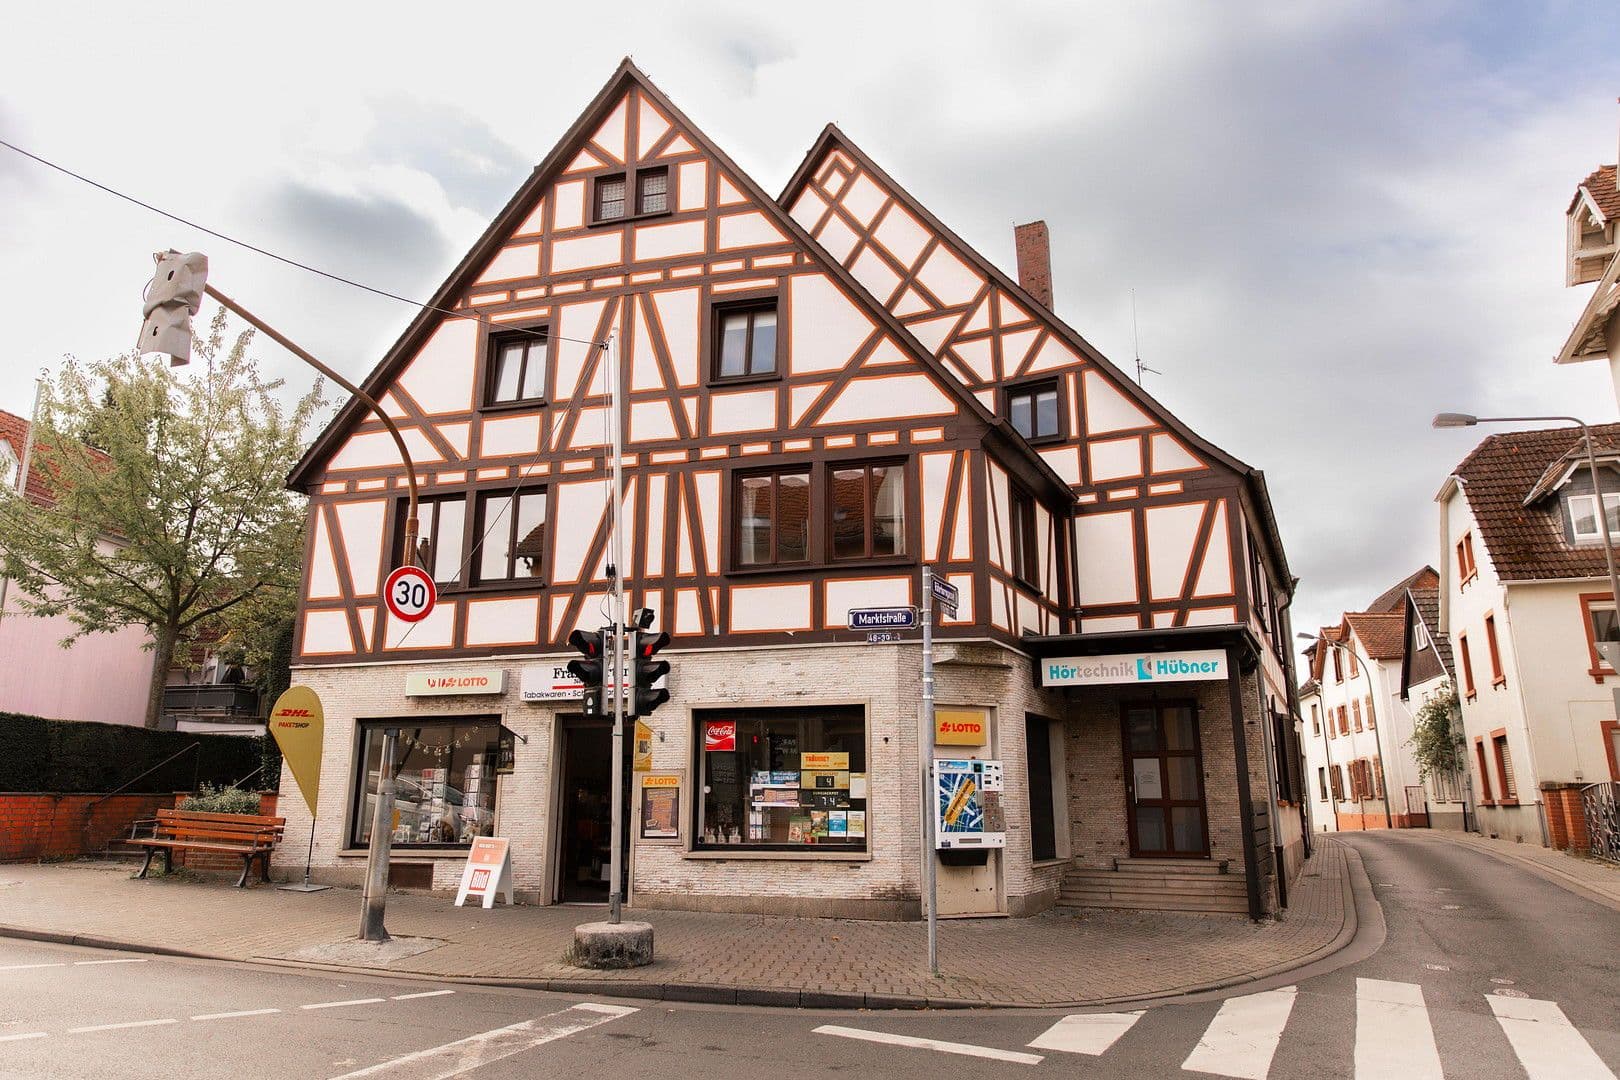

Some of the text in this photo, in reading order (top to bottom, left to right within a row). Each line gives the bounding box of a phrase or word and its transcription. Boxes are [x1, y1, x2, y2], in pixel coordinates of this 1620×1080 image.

[396, 581, 426, 609] 30
[859, 613, 907, 625] Marktstraße
[1049, 659, 1219, 680] Hörtechnik Hübner
[458, 677, 488, 687] LOTTO
[524, 689, 567, 699] Tabakwaren
[280, 709, 309, 717] DHL
[952, 723, 981, 733] LOTTO
[654, 777, 678, 785] LOTTO
